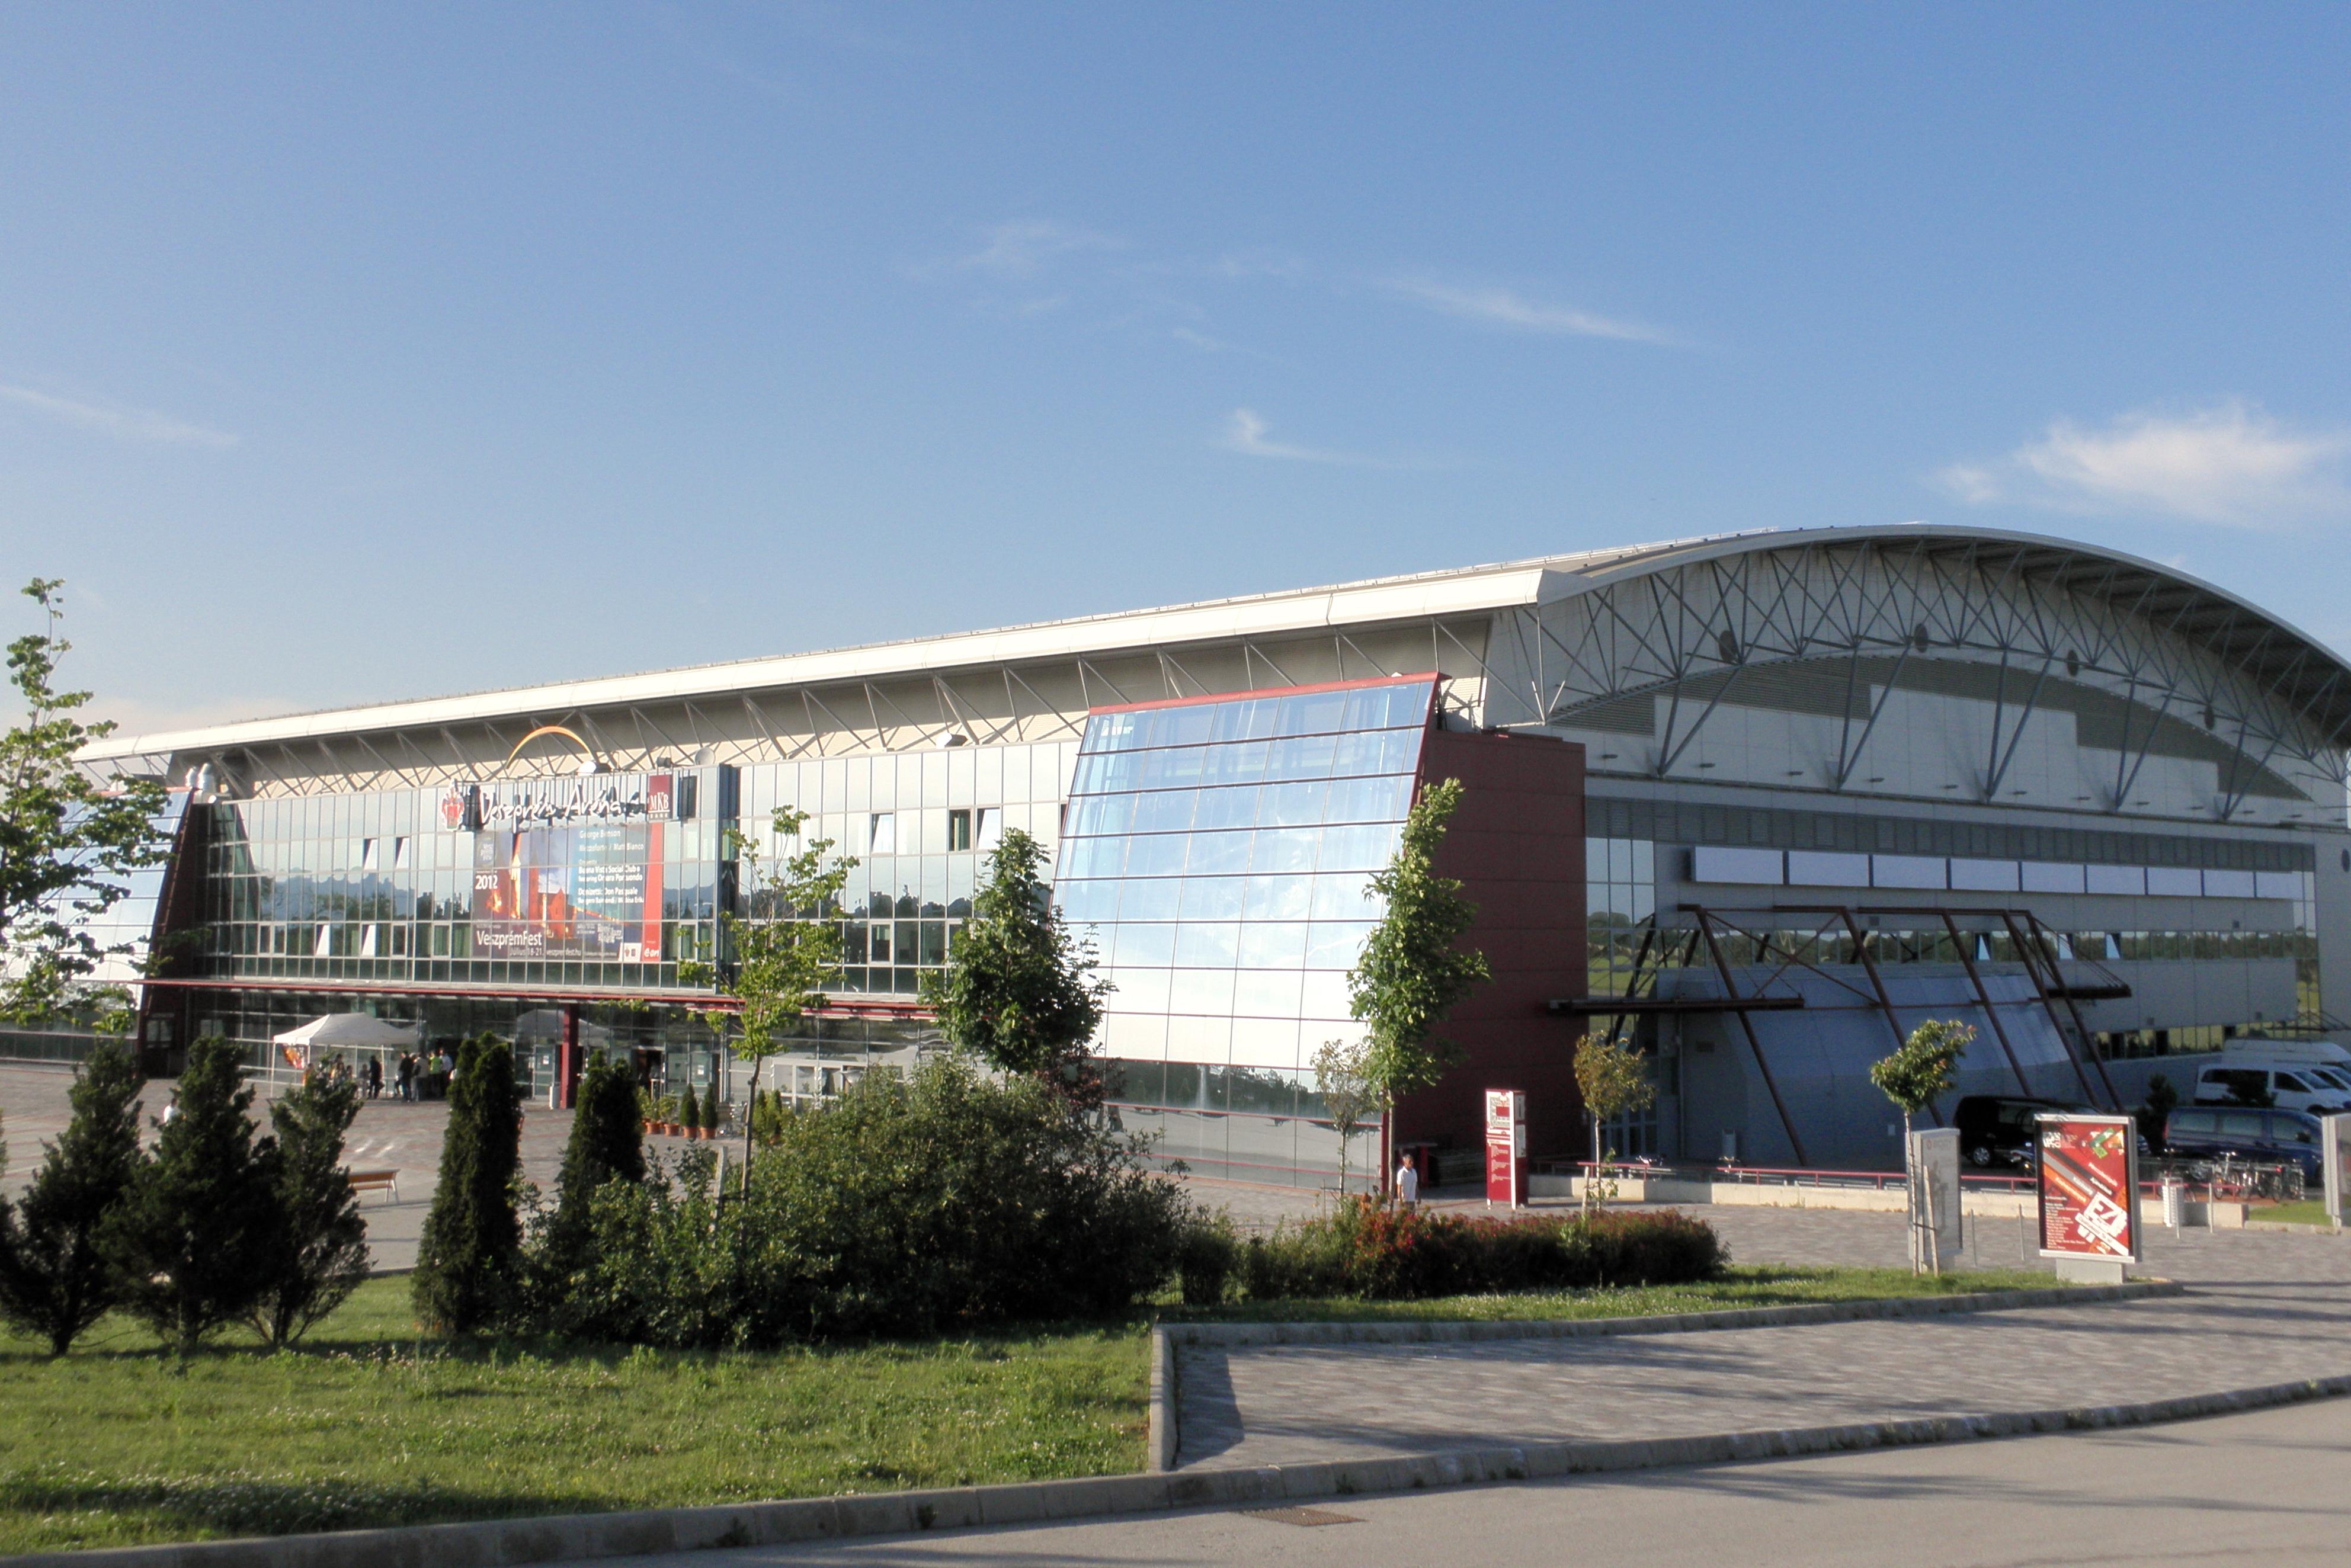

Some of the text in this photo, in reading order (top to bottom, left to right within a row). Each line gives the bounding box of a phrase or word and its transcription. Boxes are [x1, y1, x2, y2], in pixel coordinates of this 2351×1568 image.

[565, 784, 622, 817] Aréna
[649, 792, 669, 810] MKB
[475, 875, 498, 890] 2012
[476, 930, 542, 950] VeszprémFest
